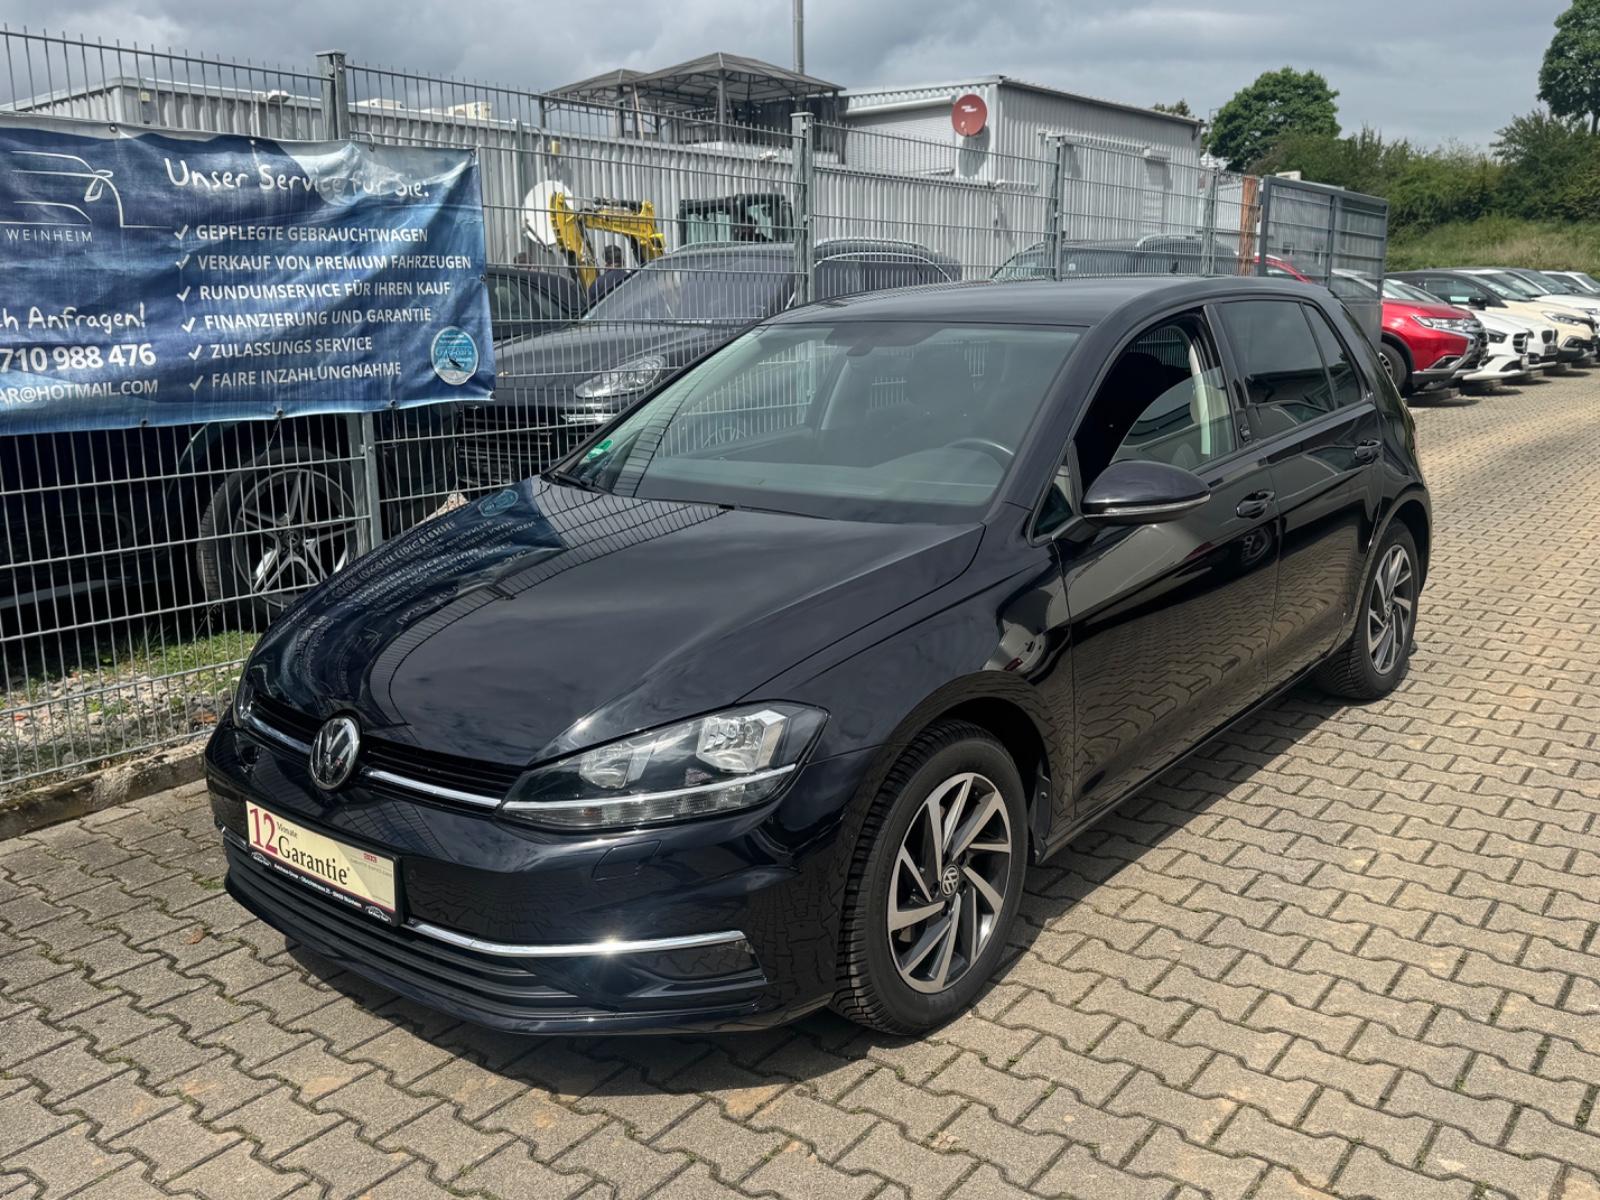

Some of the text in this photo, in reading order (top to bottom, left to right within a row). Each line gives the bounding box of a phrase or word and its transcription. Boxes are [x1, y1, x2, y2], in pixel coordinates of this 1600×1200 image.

[165, 158, 249, 189] Unser
[258, 164, 344, 193] Service
[6, 229, 93, 243] WEINHEIM
[196, 224, 428, 242] GEPFLEGTE GEBRAUCHTWAGEN
[198, 255, 472, 270] VERKAUF VON PREMIUM FAHRZEUGEN
[200, 280, 451, 300] RUNDUMSERVICE FÜR IHREN KAUF
[28, 302, 145, 334] Anfragen!
[204, 307, 432, 330] FINANZIERUNG UND GARANTIE
[52, 345, 104, 371] 988
[108, 343, 157, 367] 476
[210, 336, 373, 359] ZULASSUNGS SERVICE
[212, 362, 401, 388] FAIRE INZAHLUNGNAHME
[250, 808, 278, 854] 12
[279, 836, 347, 885] Garantie
